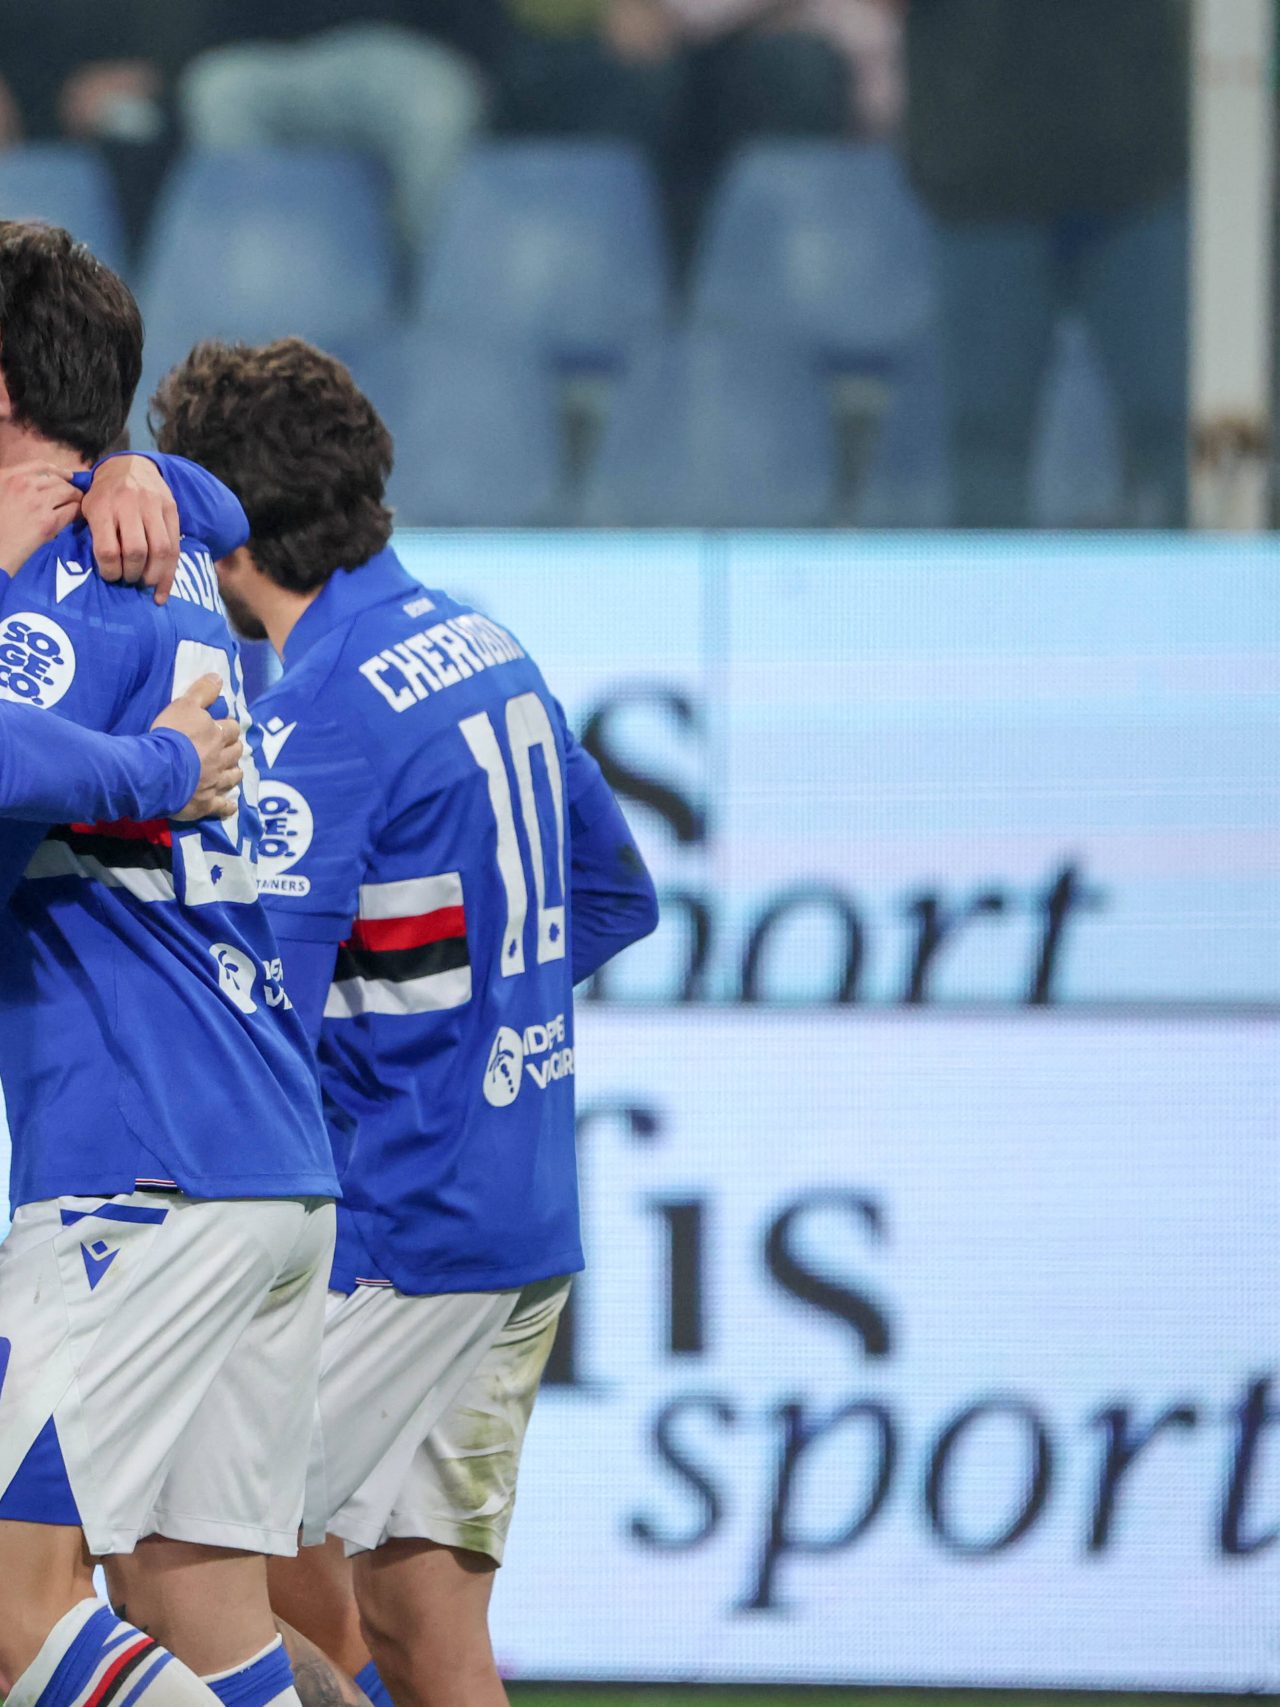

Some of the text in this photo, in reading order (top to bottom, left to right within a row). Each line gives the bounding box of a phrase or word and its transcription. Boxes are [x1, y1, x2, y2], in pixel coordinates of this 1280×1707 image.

[3, 621, 64, 665] SO.
[458, 692, 565, 978] 10
[626, 1370, 1280, 1620] sport
